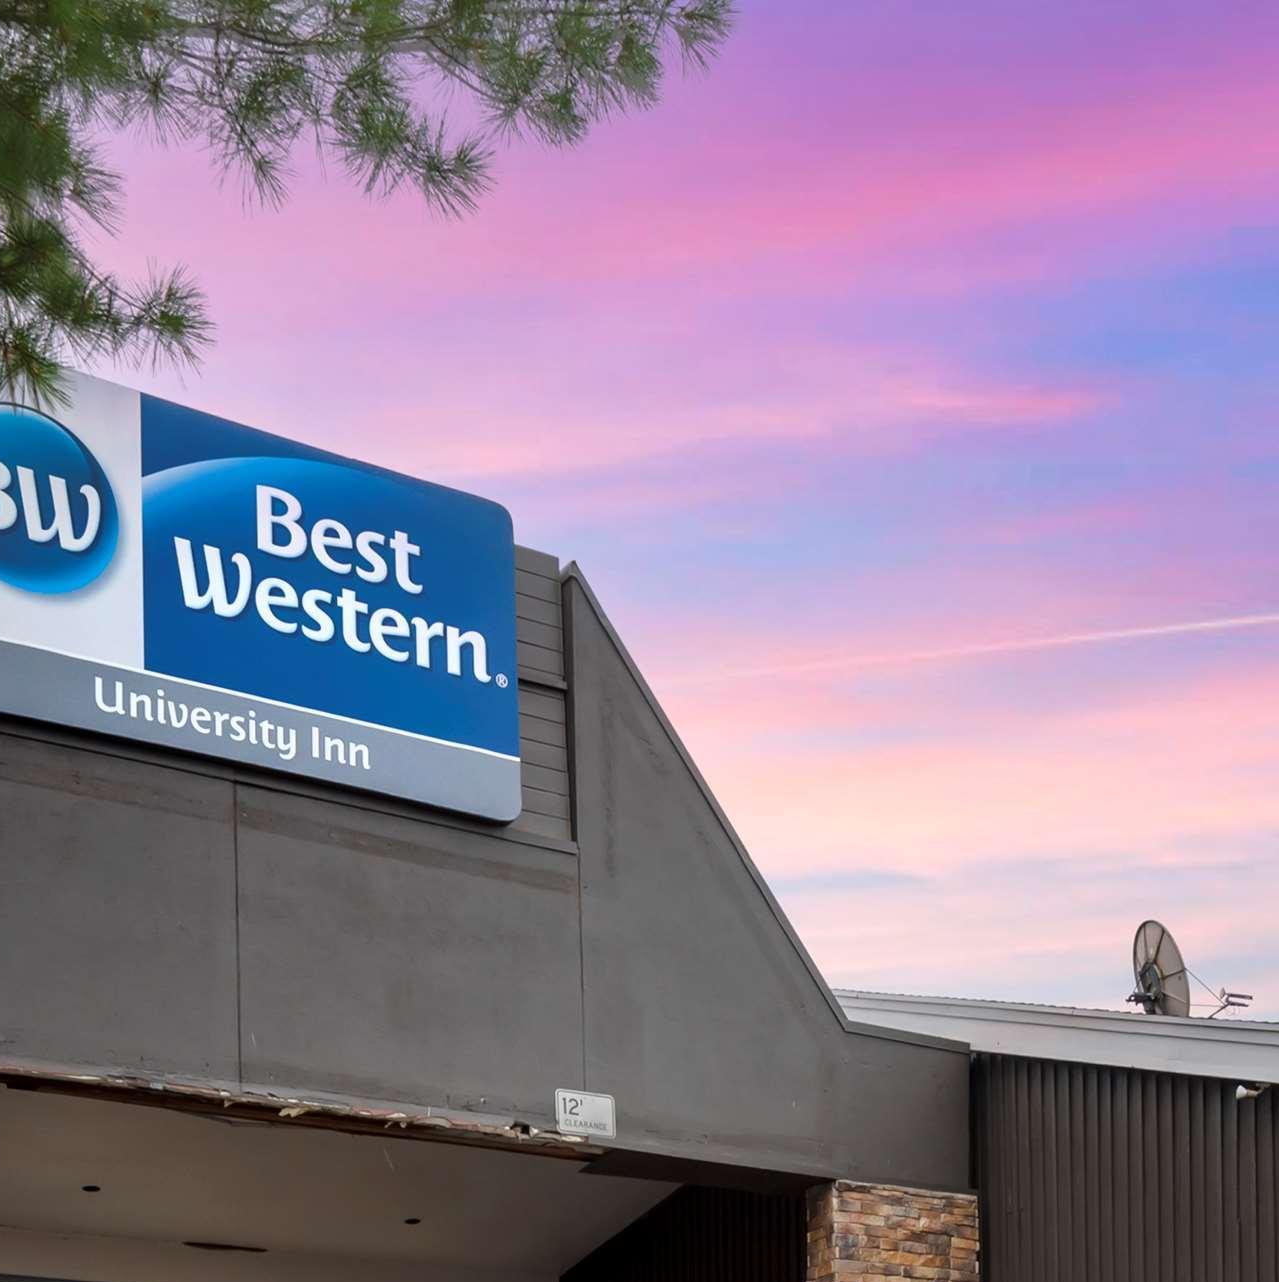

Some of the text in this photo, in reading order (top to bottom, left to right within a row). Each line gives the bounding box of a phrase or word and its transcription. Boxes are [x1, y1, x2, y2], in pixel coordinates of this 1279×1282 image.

[256, 484, 424, 595] Best
[94, 676, 371, 770] University Inn
[564, 1118, 609, 1131] CLEARANCE
